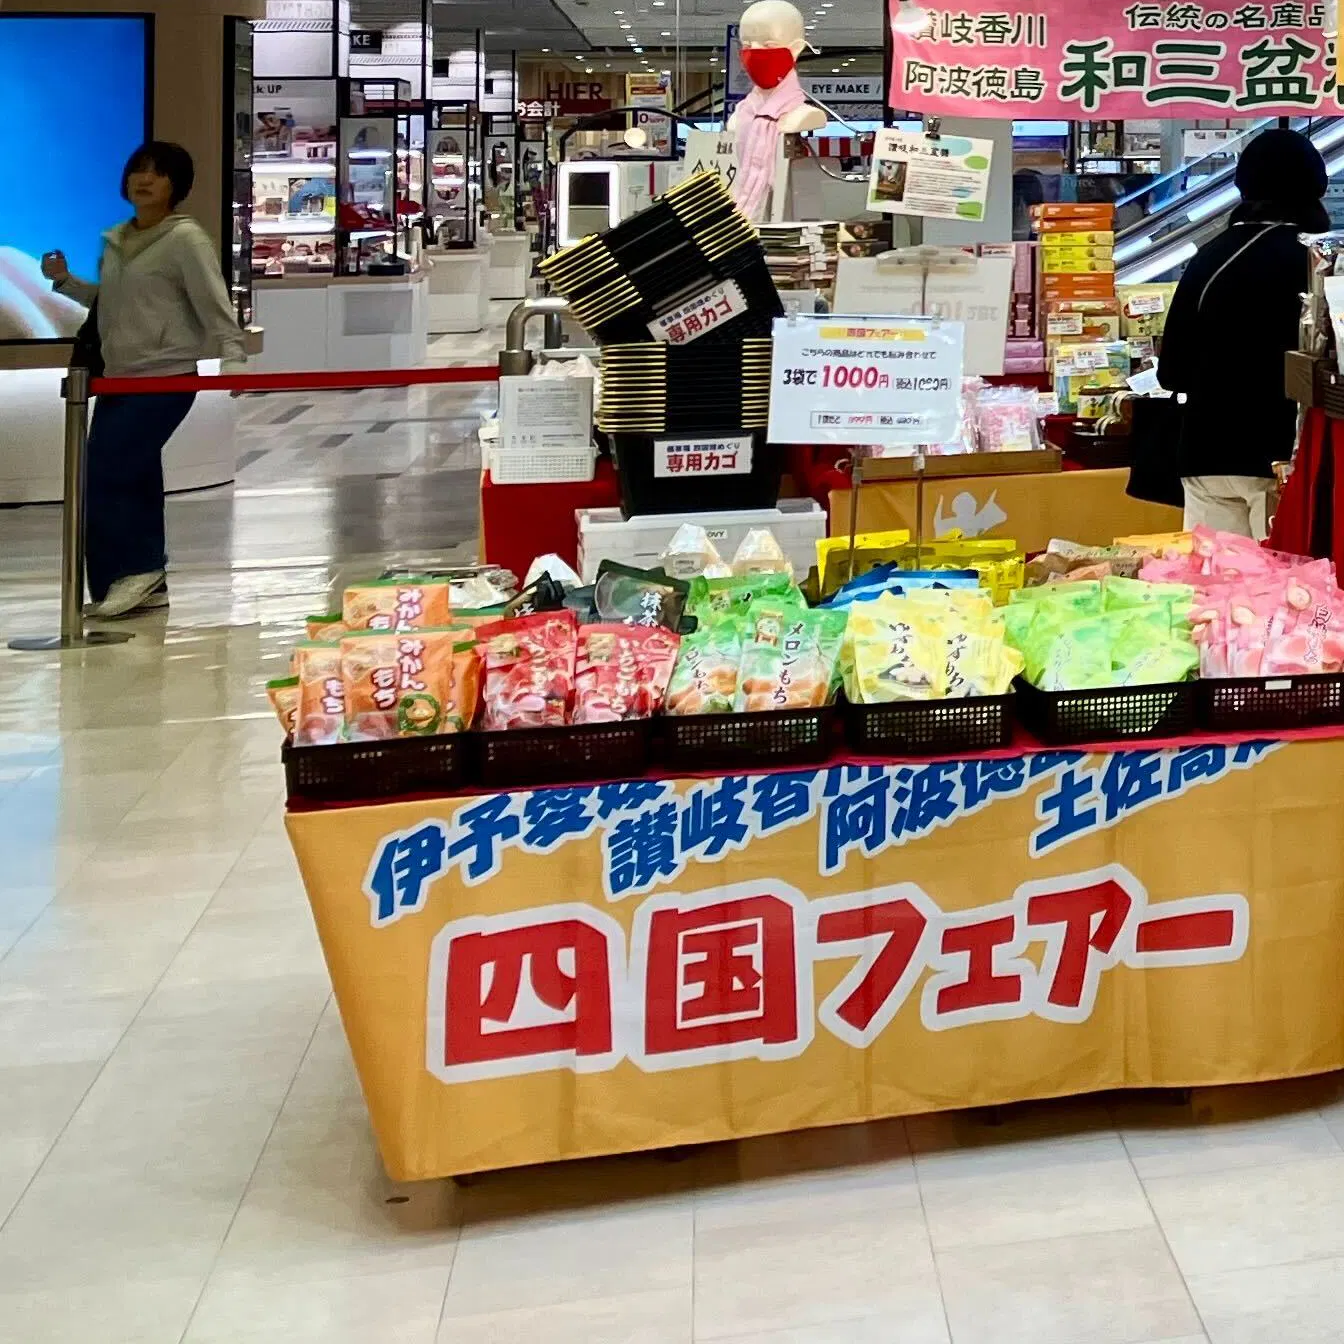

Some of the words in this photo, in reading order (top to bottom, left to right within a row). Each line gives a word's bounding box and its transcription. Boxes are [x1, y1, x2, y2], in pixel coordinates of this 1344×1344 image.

[811, 83, 832, 94] EYE
[837, 82, 870, 94] MAKE
[904, 59, 1046, 102] 阿波徳島
[666, 296, 733, 345] 専用カゴ
[822, 364, 890, 389] 1000円
[665, 451, 740, 474] 専用カゴ
[398, 639, 426, 691] みかん
[773, 622, 805, 705] メロンもち
[371, 667, 398, 709] もち
[444, 878, 1235, 1067] 四国フェアー
